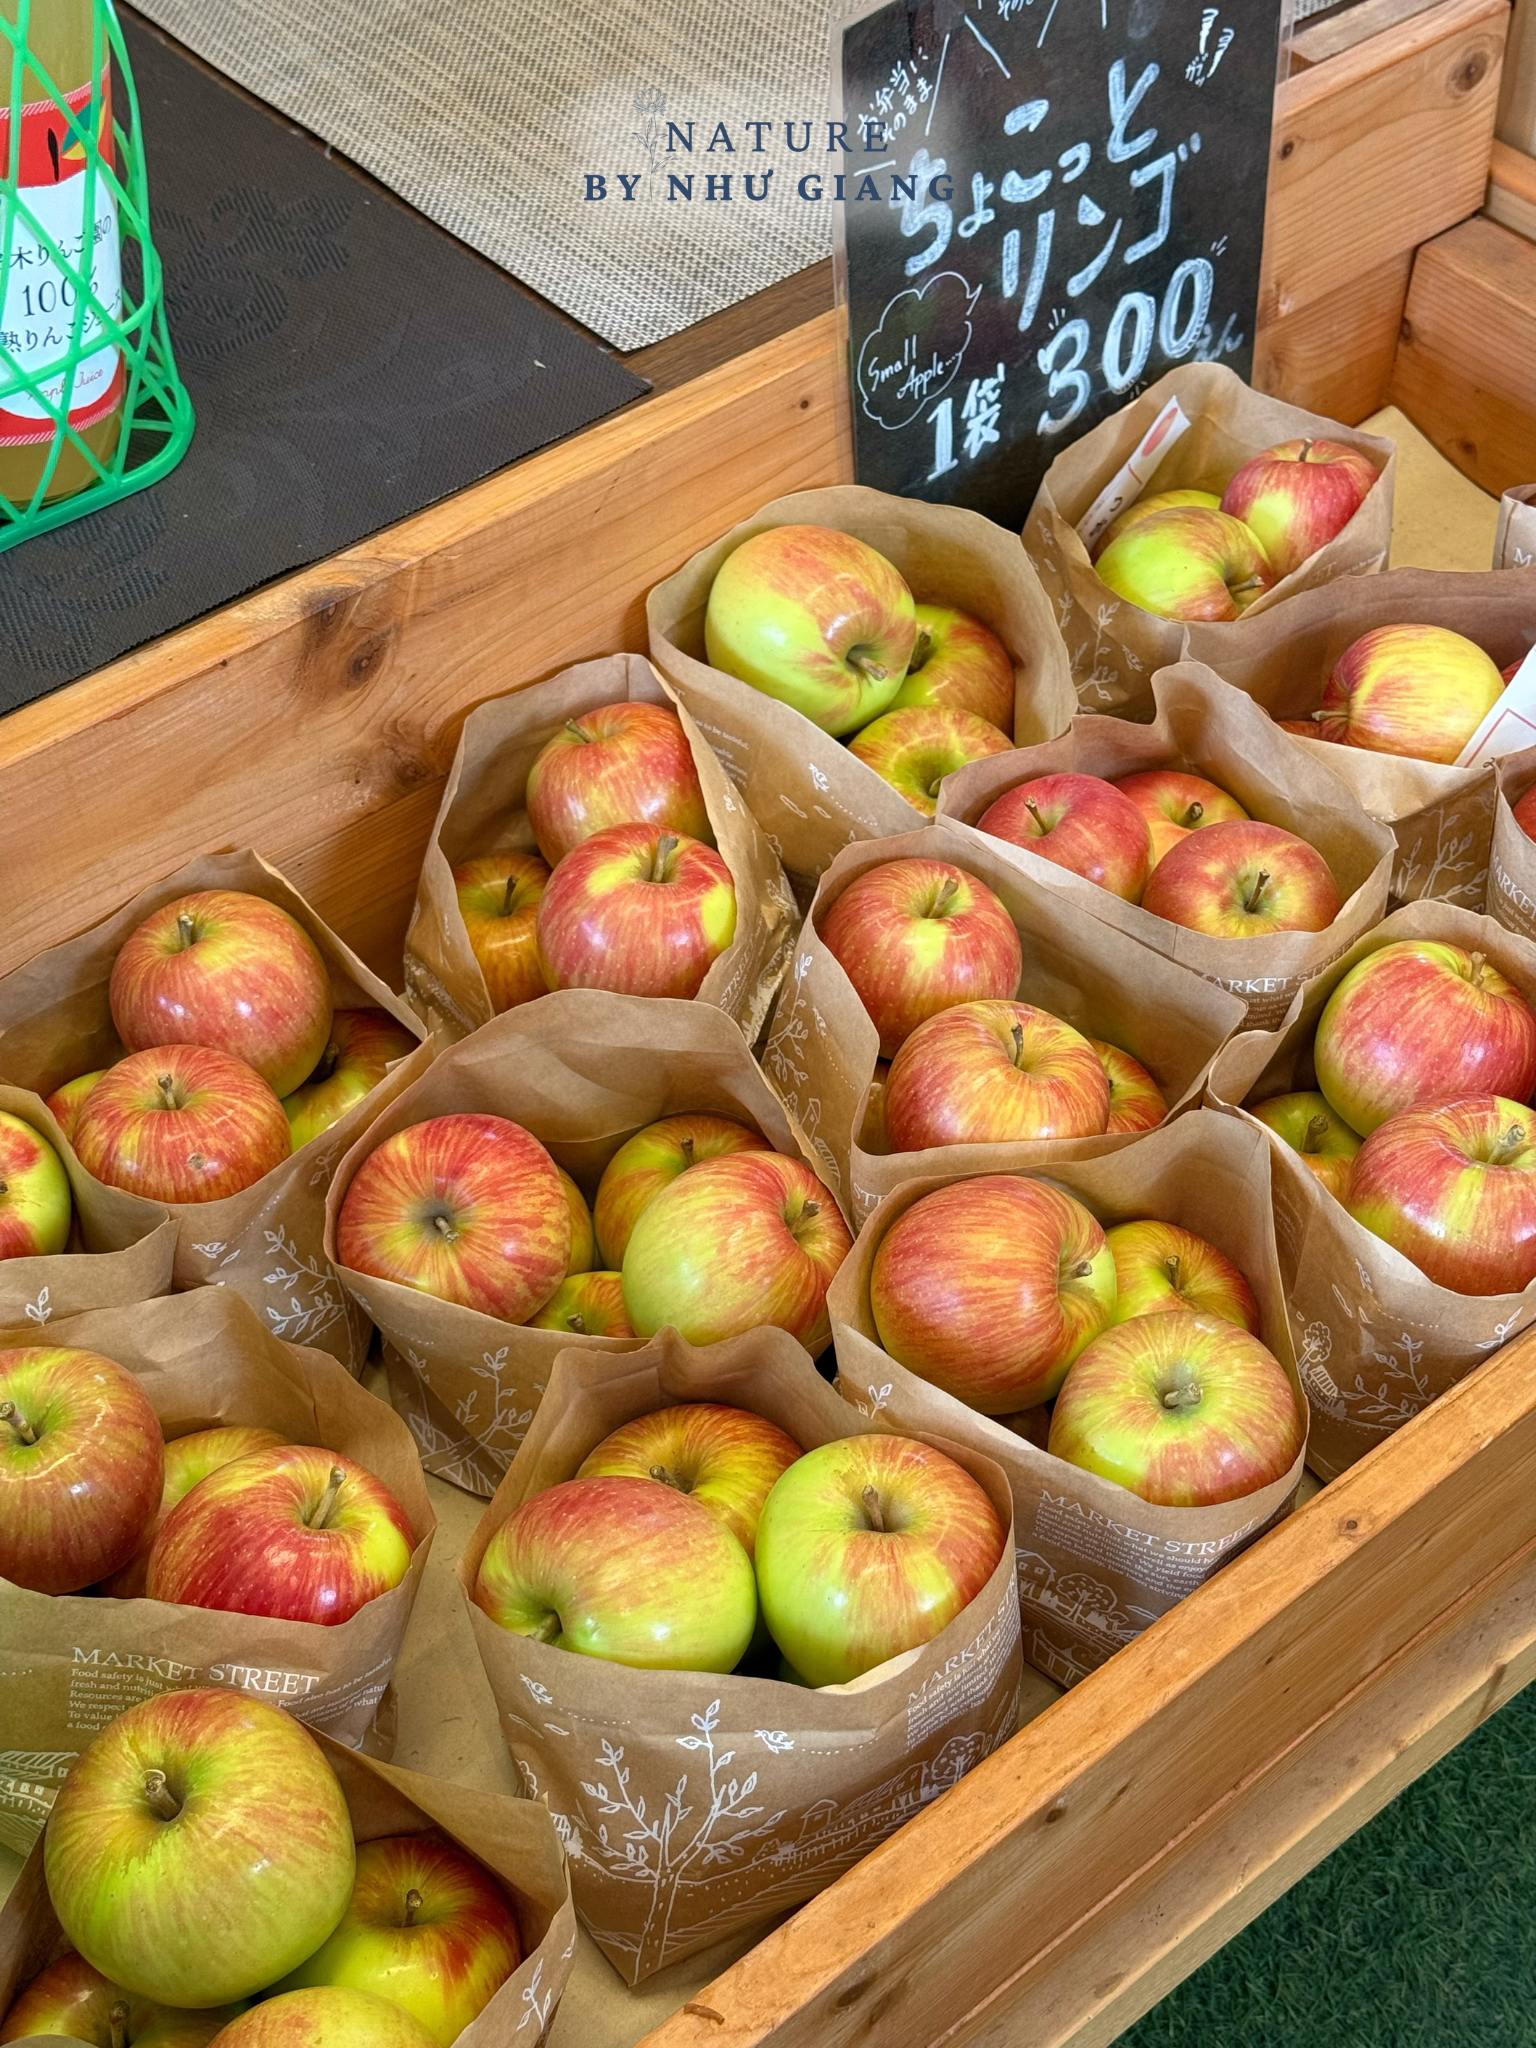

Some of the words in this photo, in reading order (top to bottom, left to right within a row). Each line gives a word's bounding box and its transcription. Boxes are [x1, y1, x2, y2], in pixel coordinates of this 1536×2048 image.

[1001, 131, 1202, 332] リンゴ
[868, 334, 917, 392] Small
[1211, 976, 1293, 994] ARKET
[1040, 1489, 1159, 1546] MARKET
[71, 1646, 203, 1681] MARKET
[208, 1663, 320, 1696] STREET
[71, 1668, 99, 1678] Food
[101, 1672, 134, 1683] safety
[99, 1682, 121, 1690] and
